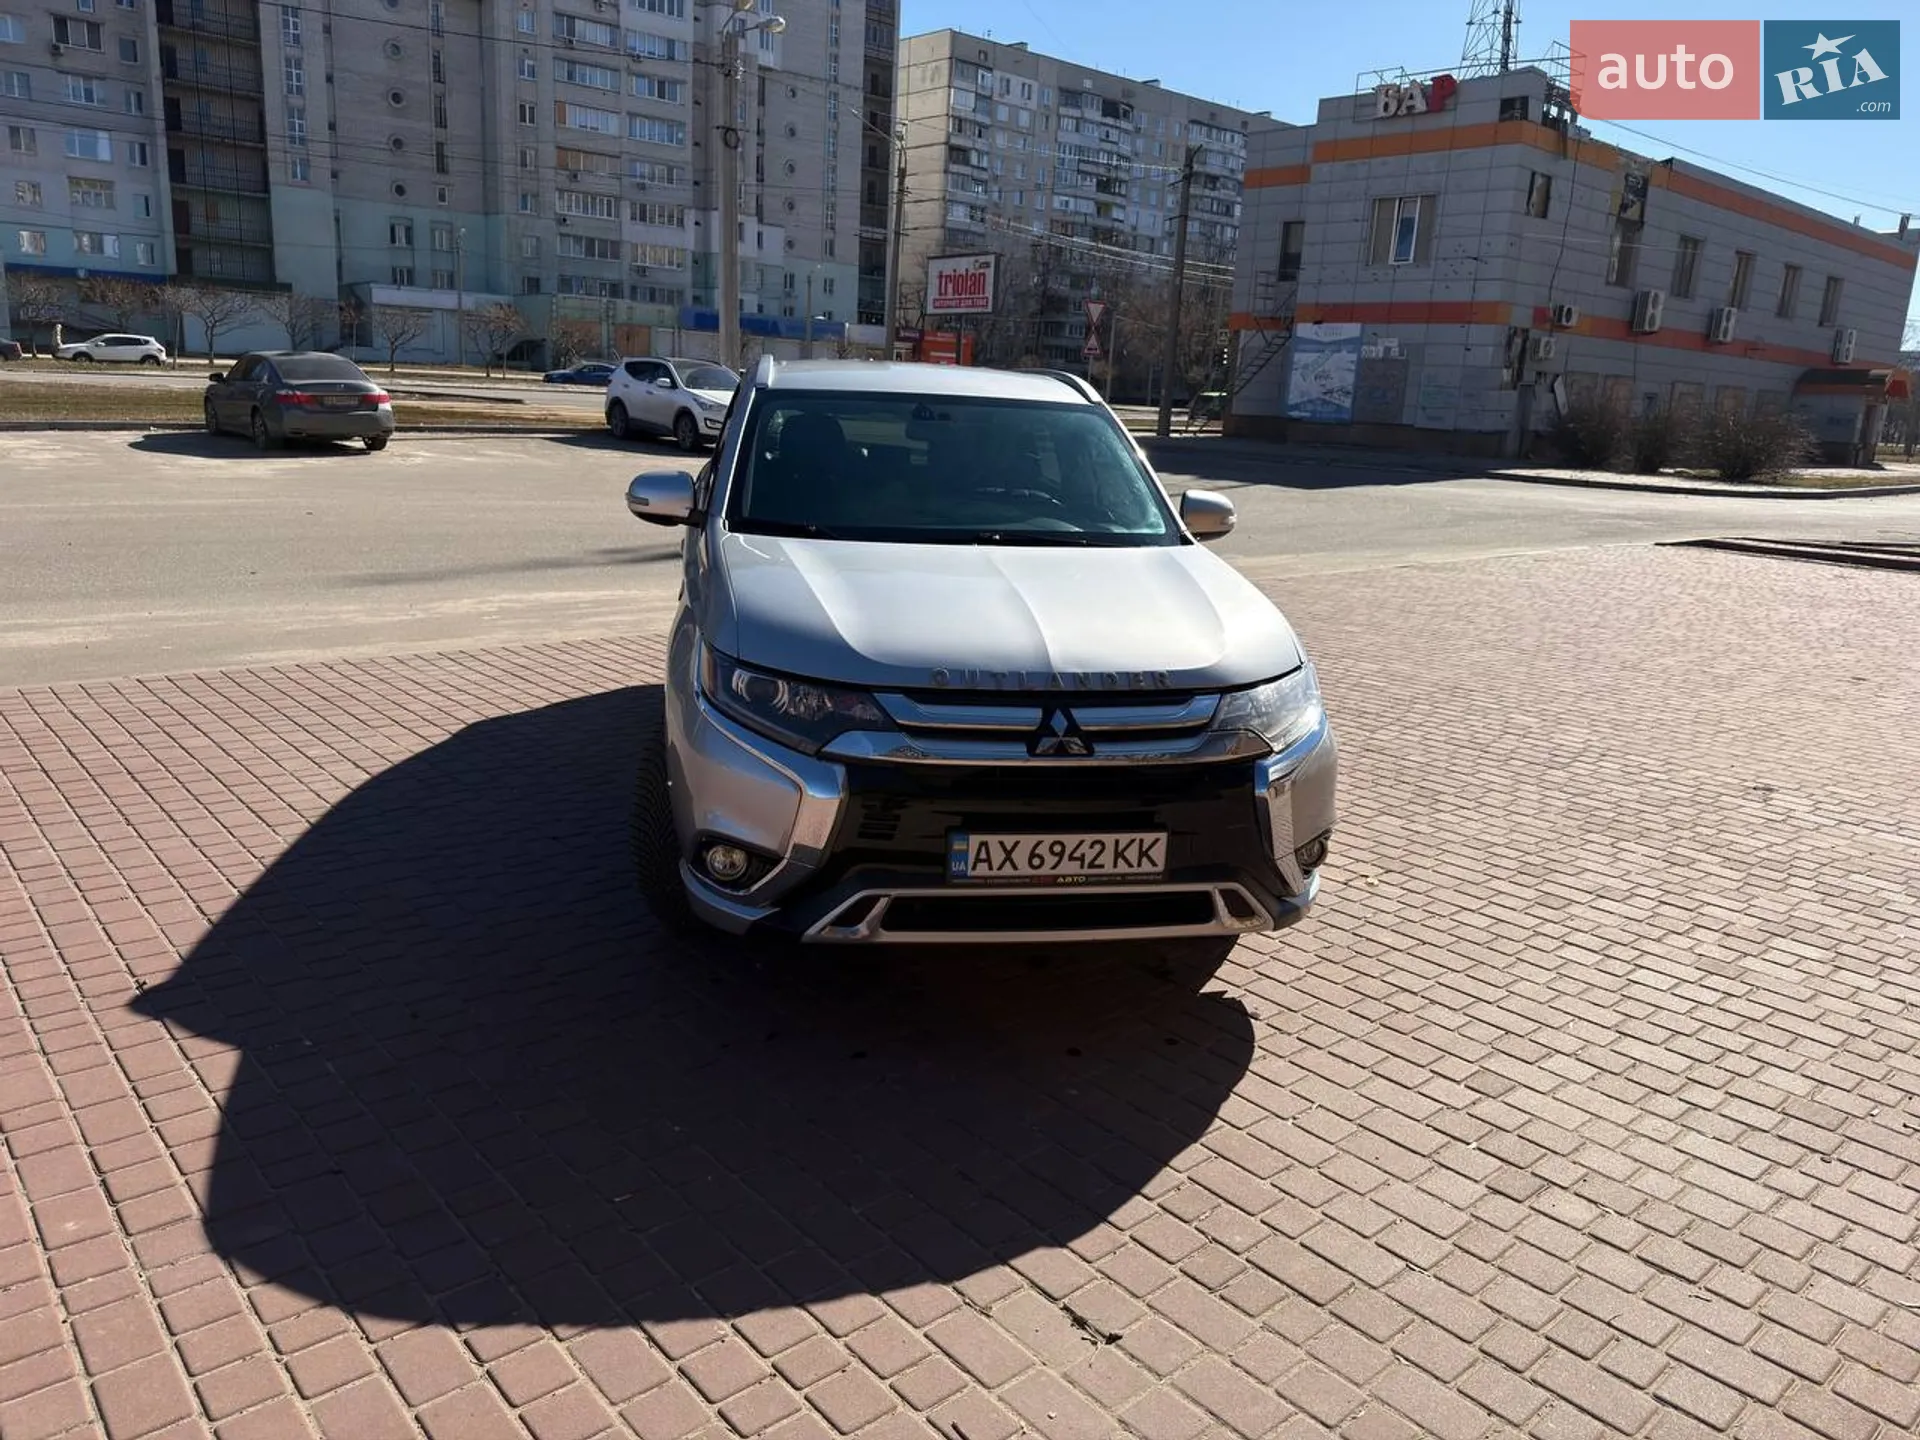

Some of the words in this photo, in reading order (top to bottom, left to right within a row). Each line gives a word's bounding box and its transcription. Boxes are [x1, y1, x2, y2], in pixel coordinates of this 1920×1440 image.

[1376, 74, 1456, 118] БАР
[937, 268, 987, 296] triolan
[931, 668, 1172, 688] OUTLANDER
[951, 861, 966, 872] UA
